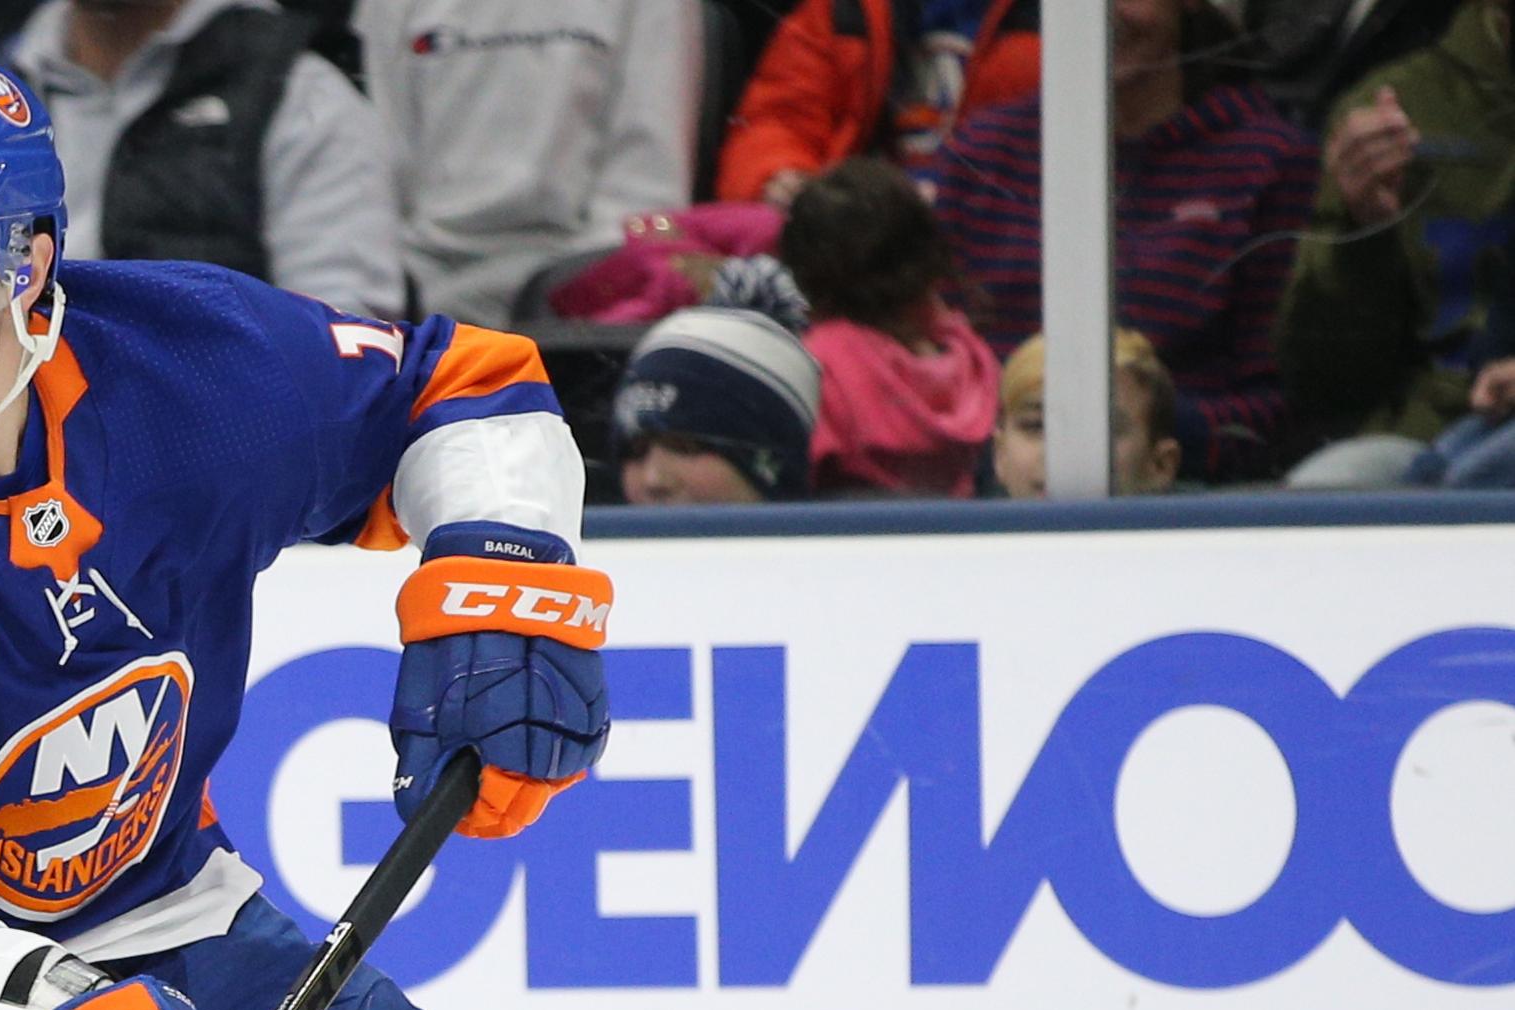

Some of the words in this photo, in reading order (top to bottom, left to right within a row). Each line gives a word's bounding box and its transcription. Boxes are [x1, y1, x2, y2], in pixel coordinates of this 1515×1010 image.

[328, 322, 405, 376] 1
[484, 541, 535, 560] BARZAL
[441, 582, 610, 632] CCM
